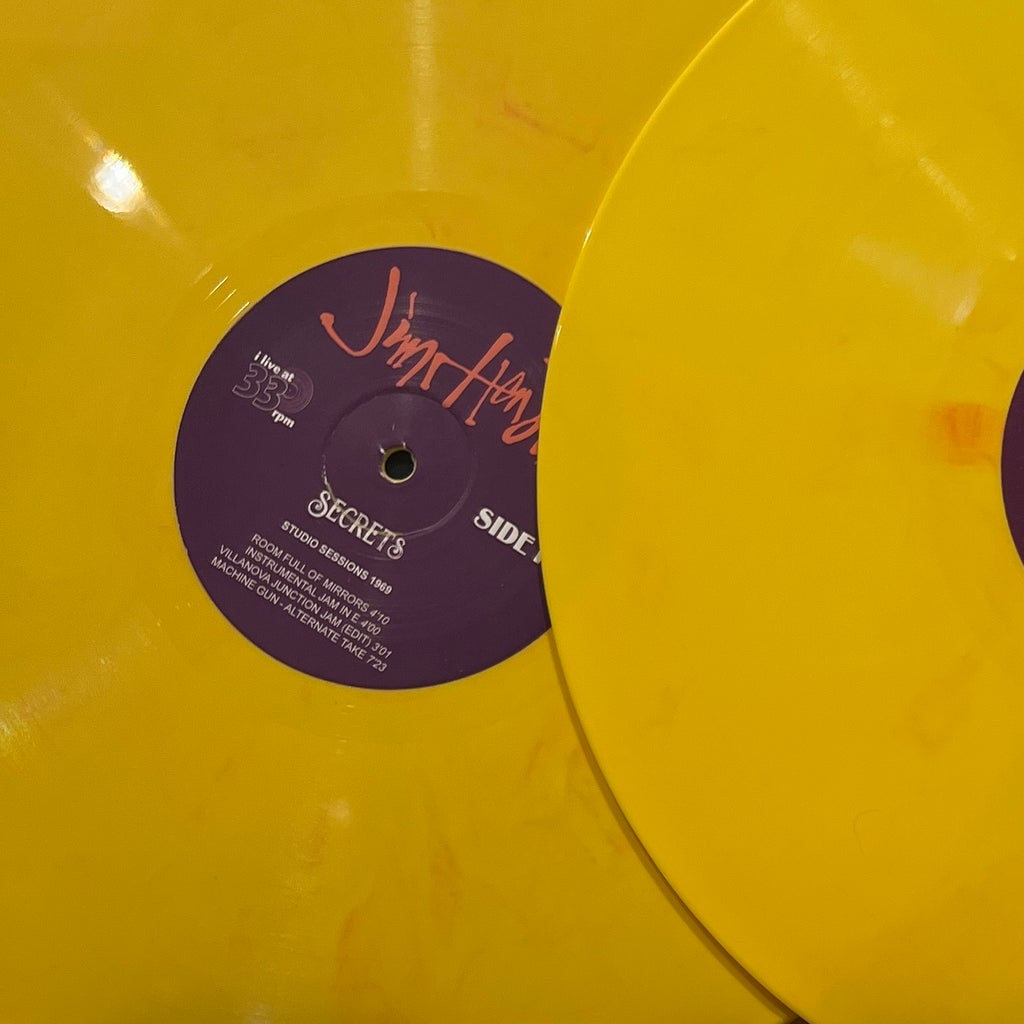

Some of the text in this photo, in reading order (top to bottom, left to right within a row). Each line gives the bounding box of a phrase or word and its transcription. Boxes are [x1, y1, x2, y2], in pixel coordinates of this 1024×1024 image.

[232, 363, 289, 411] 33
[254, 350, 295, 383] i live at
[271, 409, 295, 429] rpm
[281, 520, 393, 595] STUDIO SESSIONS 1969
[307, 490, 406, 560] SECRETS
[473, 507, 536, 556] SIDE
[210, 556, 258, 591] MACHINE
[256, 585, 281, 606] GUN
[283, 603, 341, 644] ALTERNATE
[340, 637, 368, 660] TAKE
[219, 544, 272, 584] VILLANOVA
[270, 579, 322, 615] JUNCTION
[320, 610, 343, 628] JAM
[340, 623, 372, 648] (EDIT)
[244, 545, 317, 598] INSTRUMENTAL
[317, 593, 341, 611] JAM
[339, 605, 353, 618] IN
[351, 612, 361, 624] E
[251, 533, 284, 559] ROOM
[282, 552, 306, 575] FULL
[307, 569, 324, 583] OF
[322, 578, 370, 613] MIRRORS
